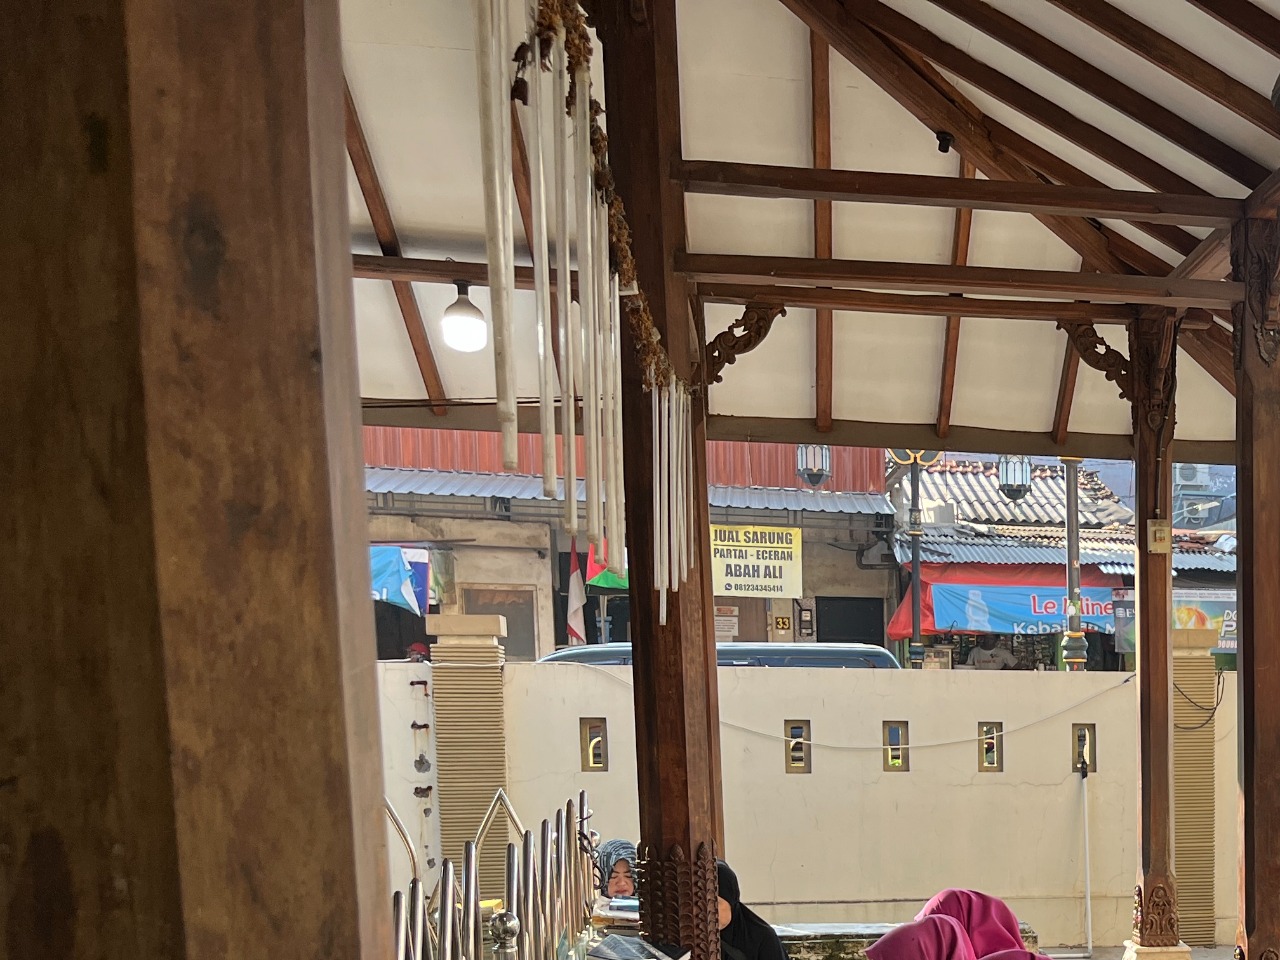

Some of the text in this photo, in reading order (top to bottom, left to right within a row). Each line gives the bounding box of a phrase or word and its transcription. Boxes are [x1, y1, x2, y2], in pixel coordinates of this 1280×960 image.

[713, 529, 793, 545] JUAL SARUNG
[713, 547, 748, 560] PARTAI
[756, 549, 793, 561] ECERAN
[725, 563, 783, 579] ABAH ALI
[1031, 594, 1057, 615] Le
[776, 618, 789, 629] 33
